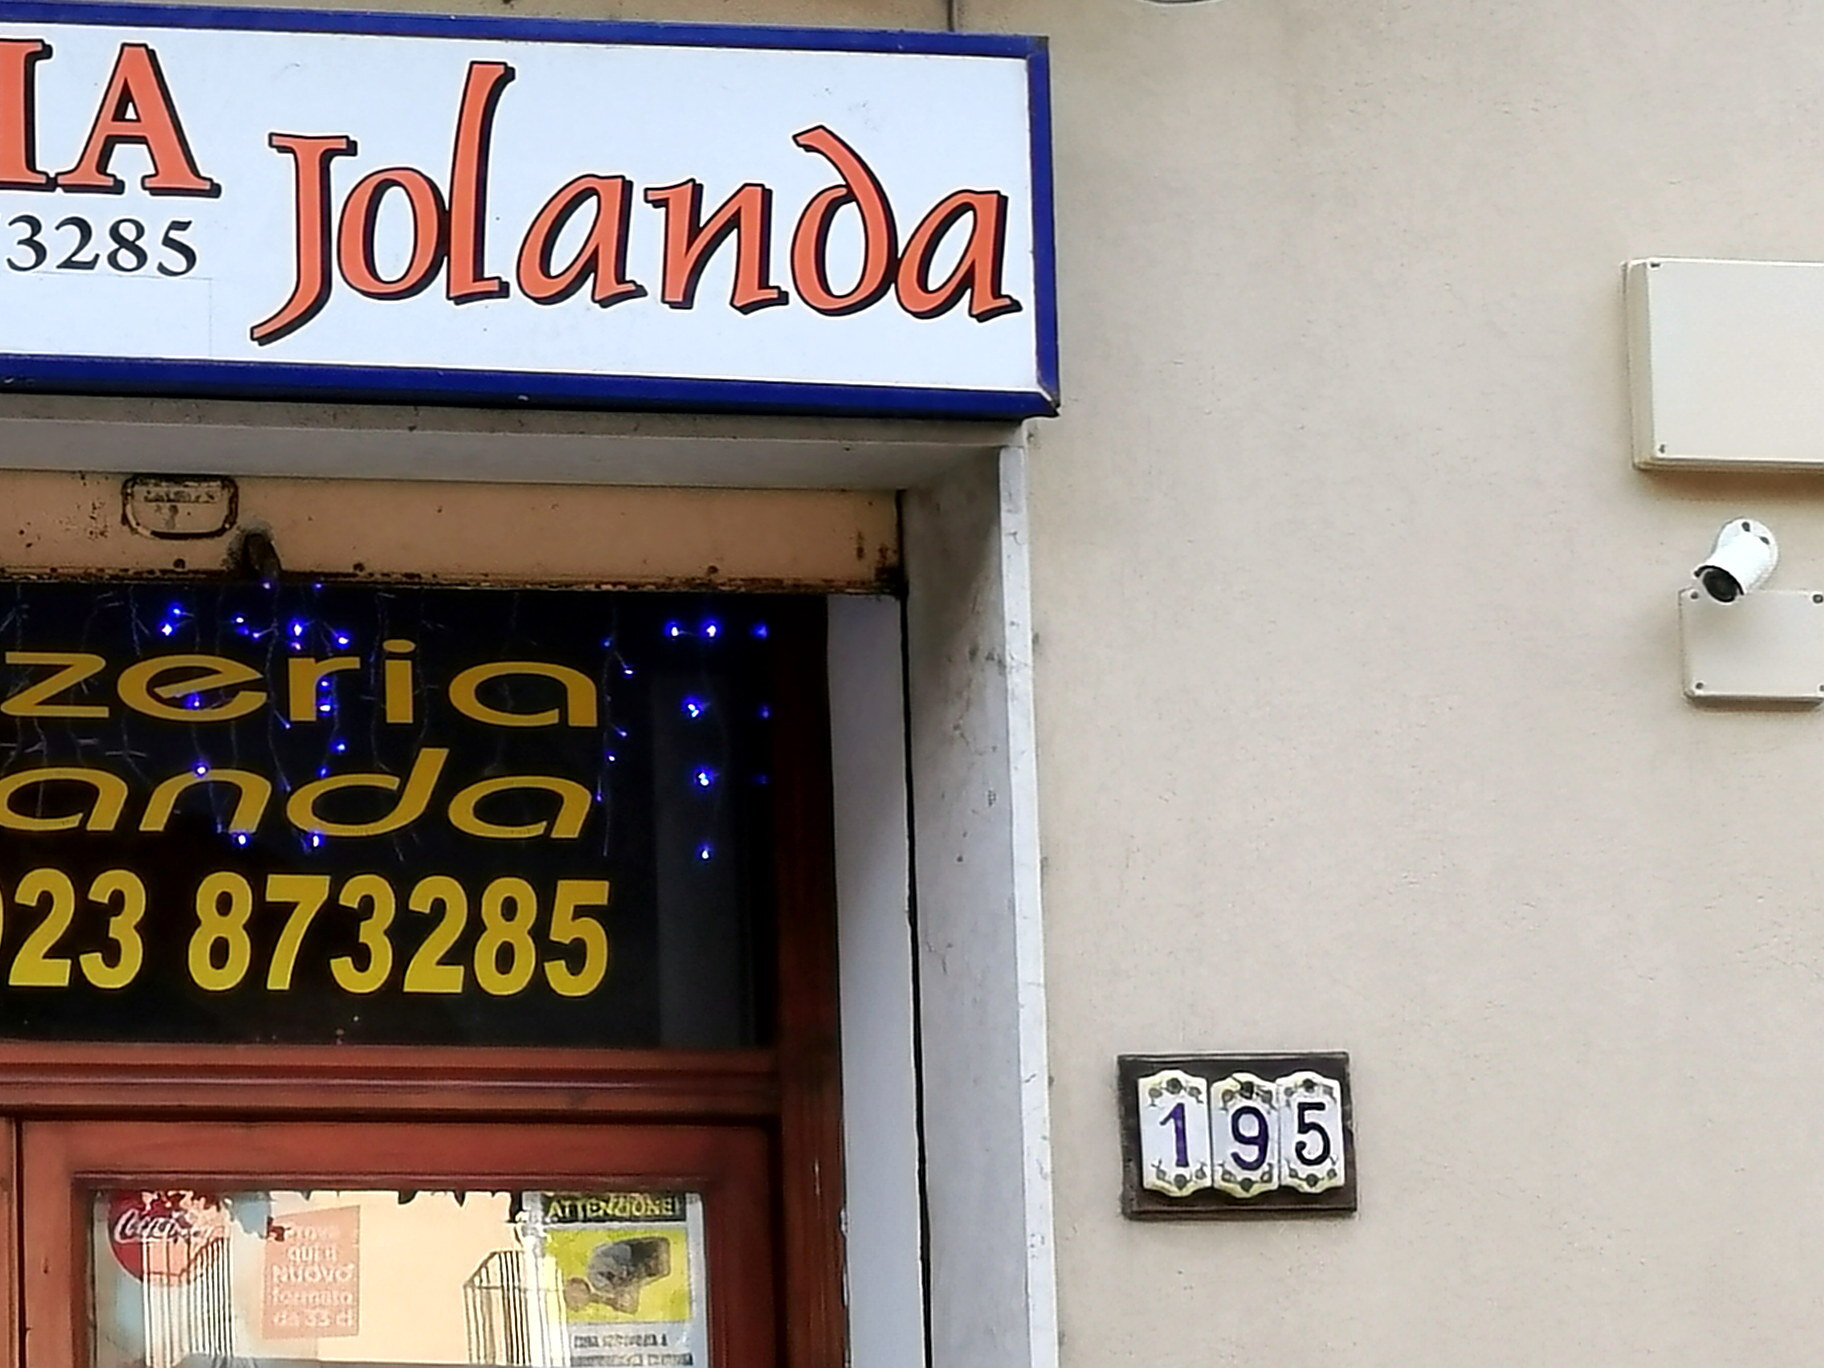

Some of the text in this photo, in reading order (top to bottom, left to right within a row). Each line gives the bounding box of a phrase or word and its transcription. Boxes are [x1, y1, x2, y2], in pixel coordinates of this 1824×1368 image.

[250, 61, 1021, 346] Jolanda
[188, 872, 610, 996] 873285
[1159, 1101, 1331, 1171] 195
